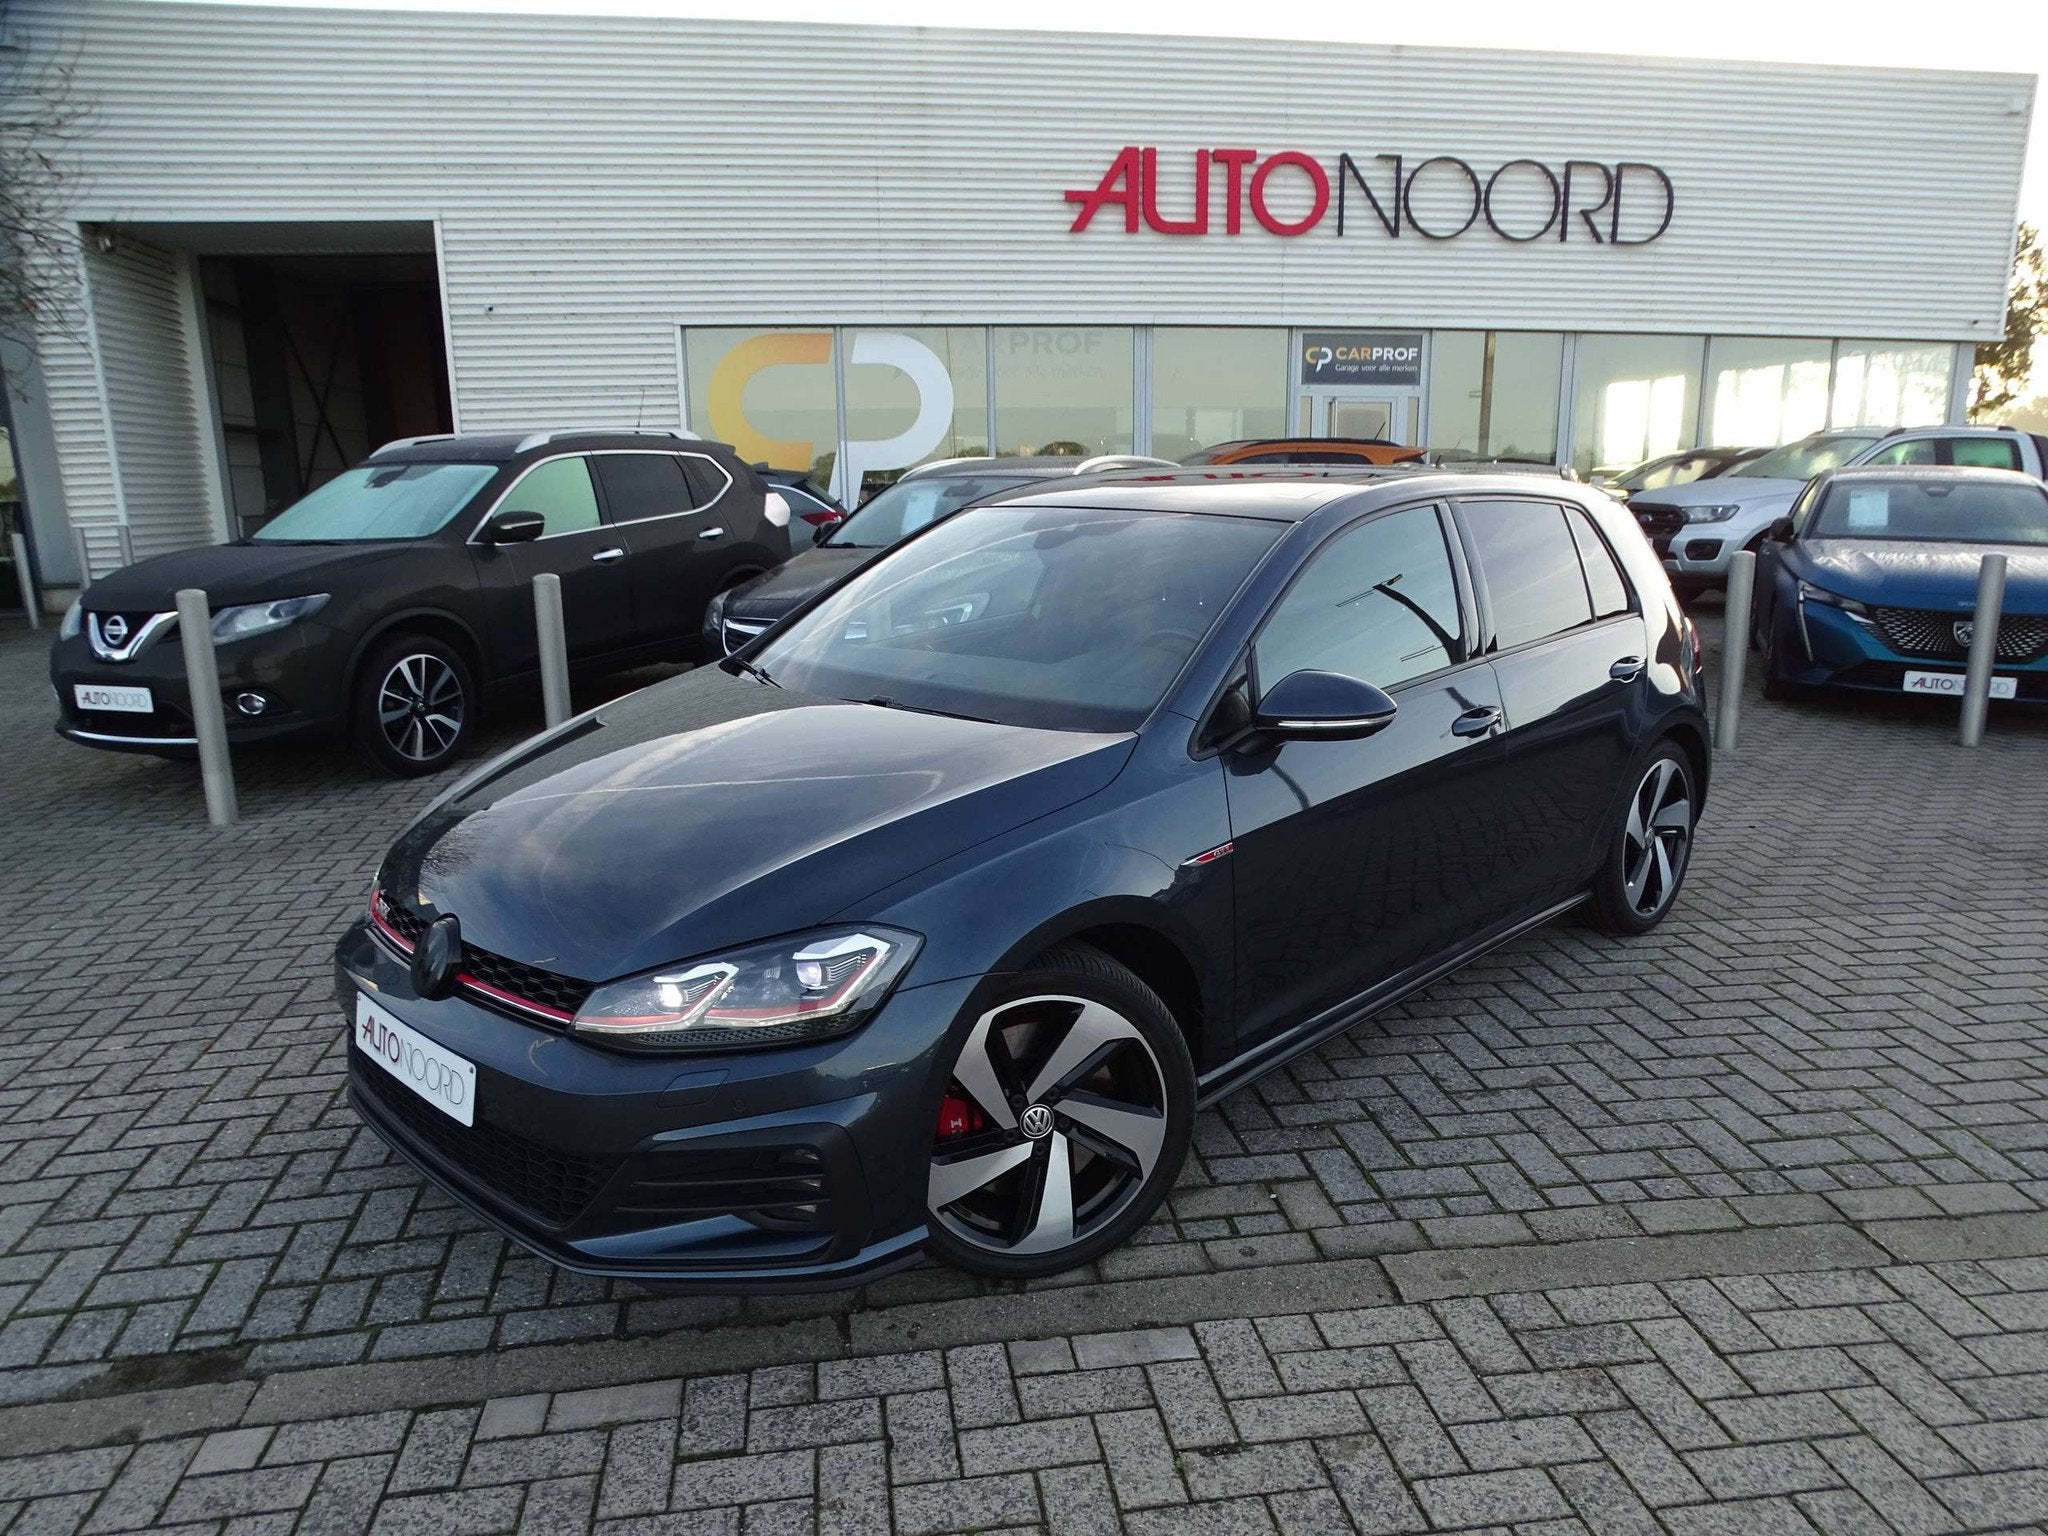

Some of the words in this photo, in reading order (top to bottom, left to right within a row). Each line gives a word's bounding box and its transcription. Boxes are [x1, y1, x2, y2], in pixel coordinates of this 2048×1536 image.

[1336, 346, 1418, 361] CARPROF
[1335, 363, 1360, 374] Garage
[1378, 364, 1391, 372] alle
[1392, 364, 1418, 372] merken
